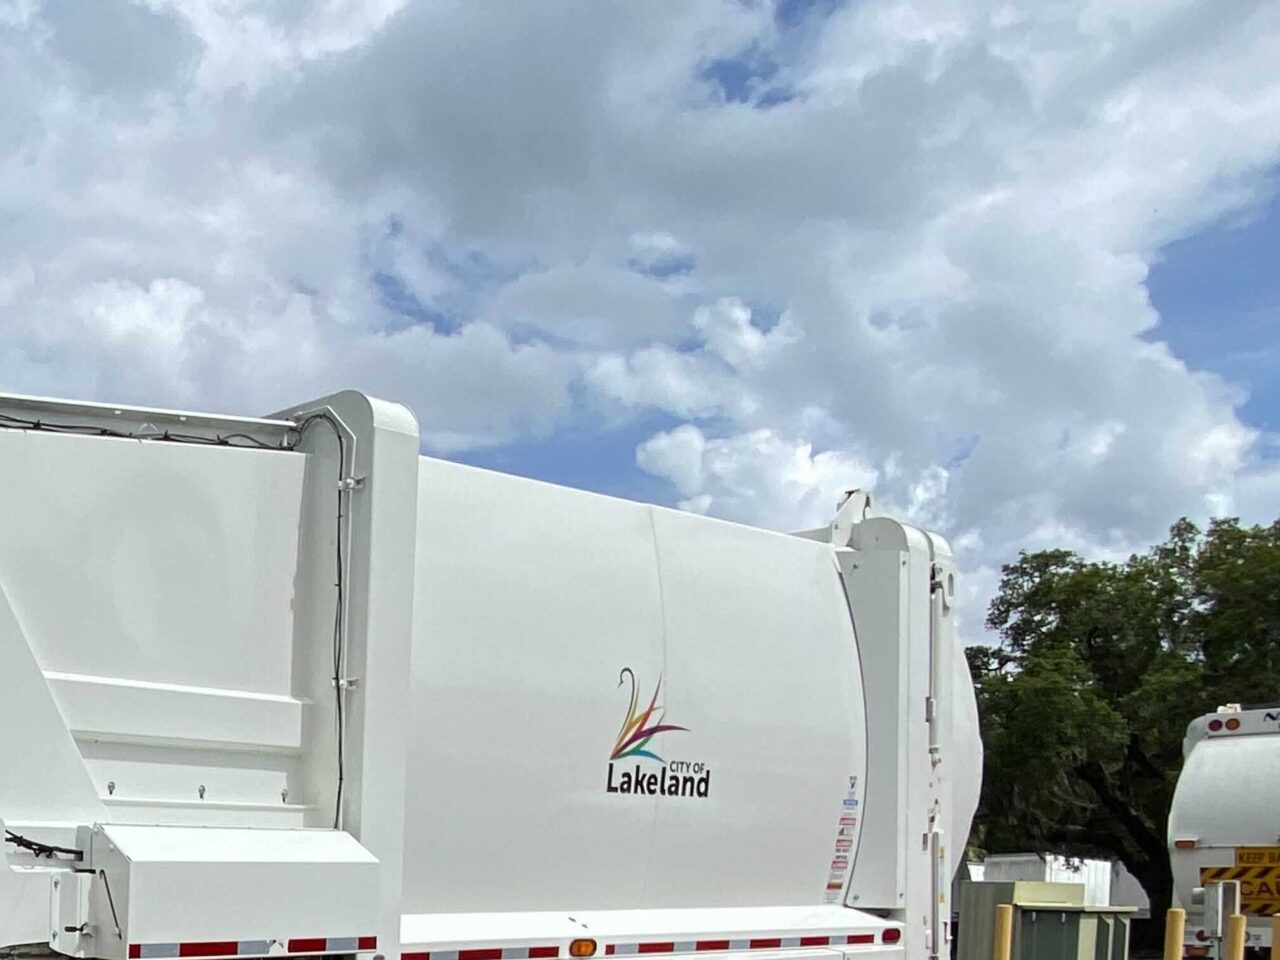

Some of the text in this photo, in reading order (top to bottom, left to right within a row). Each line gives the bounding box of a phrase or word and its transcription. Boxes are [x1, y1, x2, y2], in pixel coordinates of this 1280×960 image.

[669, 760, 705, 774] CITY OF
[606, 762, 710, 798] Lakeland
[1239, 852, 1264, 864] KEEP
